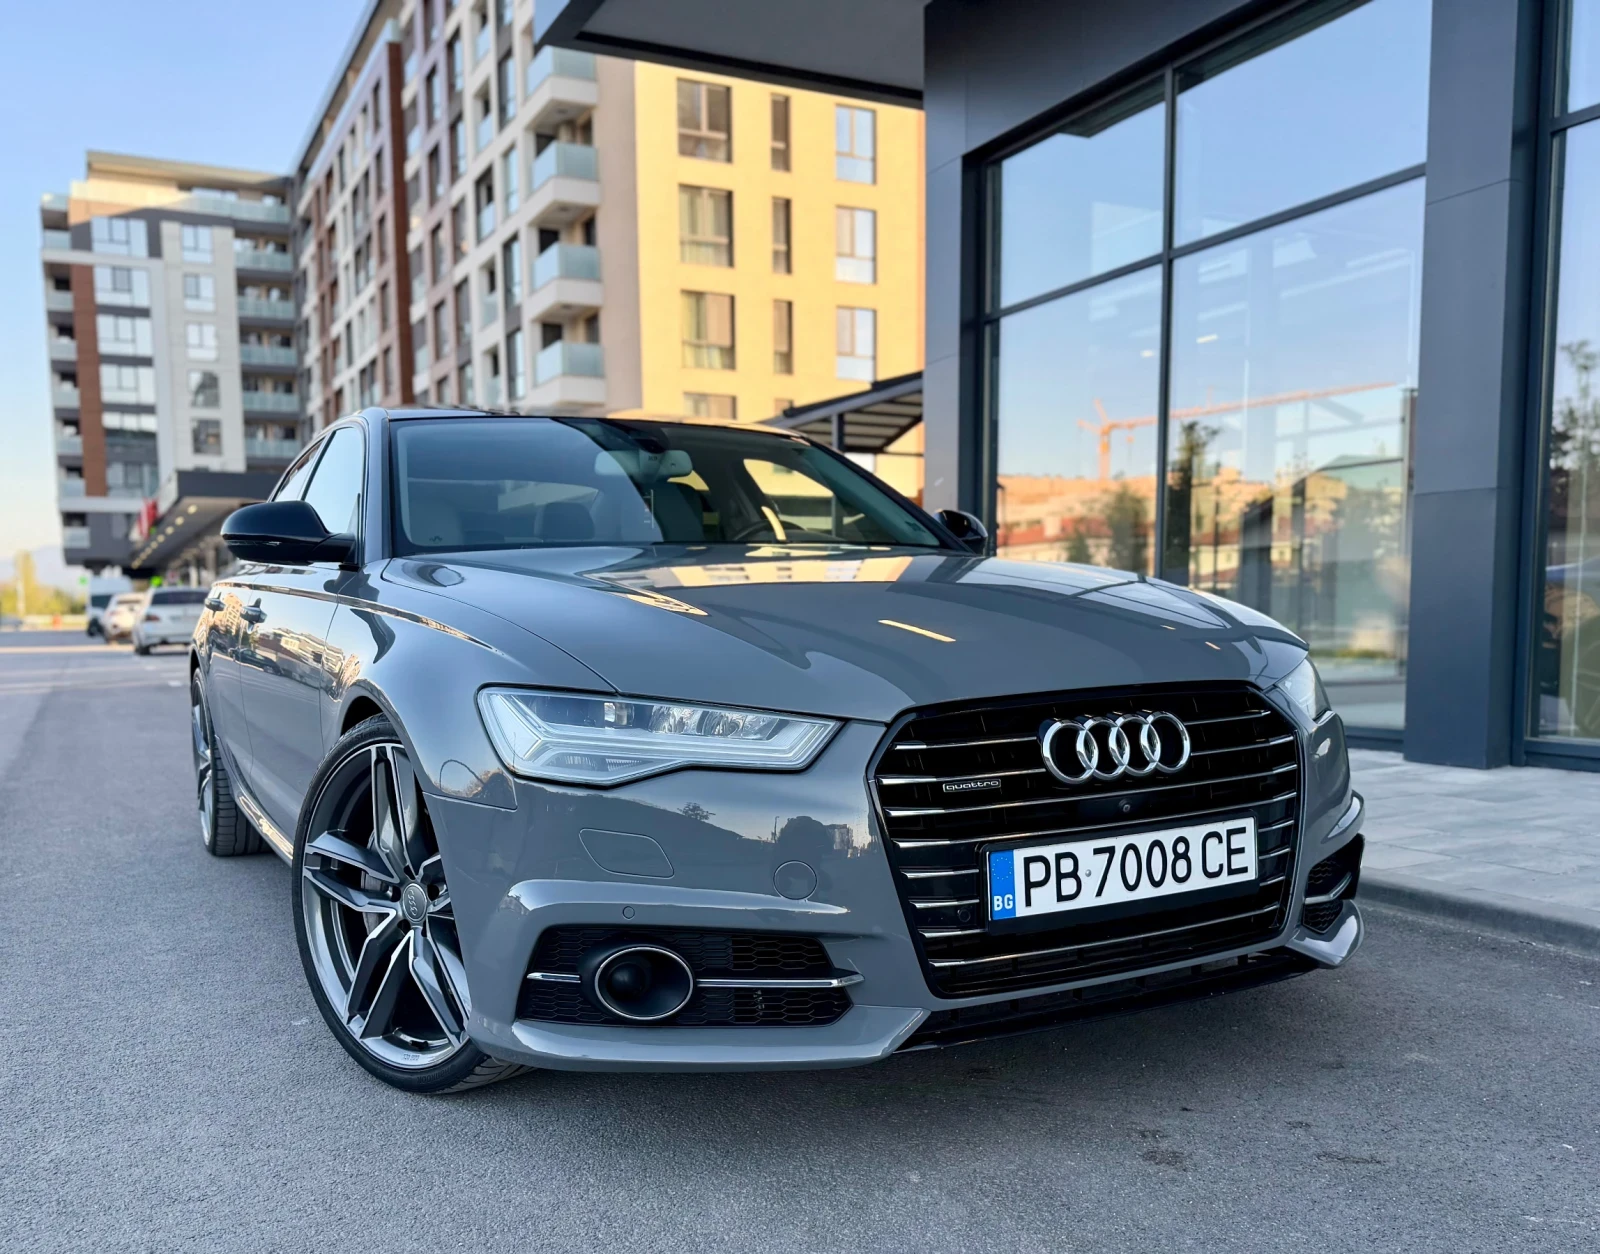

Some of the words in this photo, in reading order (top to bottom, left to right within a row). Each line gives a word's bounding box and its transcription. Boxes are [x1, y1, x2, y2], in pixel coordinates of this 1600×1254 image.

[946, 781, 999, 791] quattro
[1023, 851, 1082, 907] PB
[1092, 835, 1192, 898] 7008
[1201, 827, 1249, 879] CE
[993, 894, 1014, 911] BG
